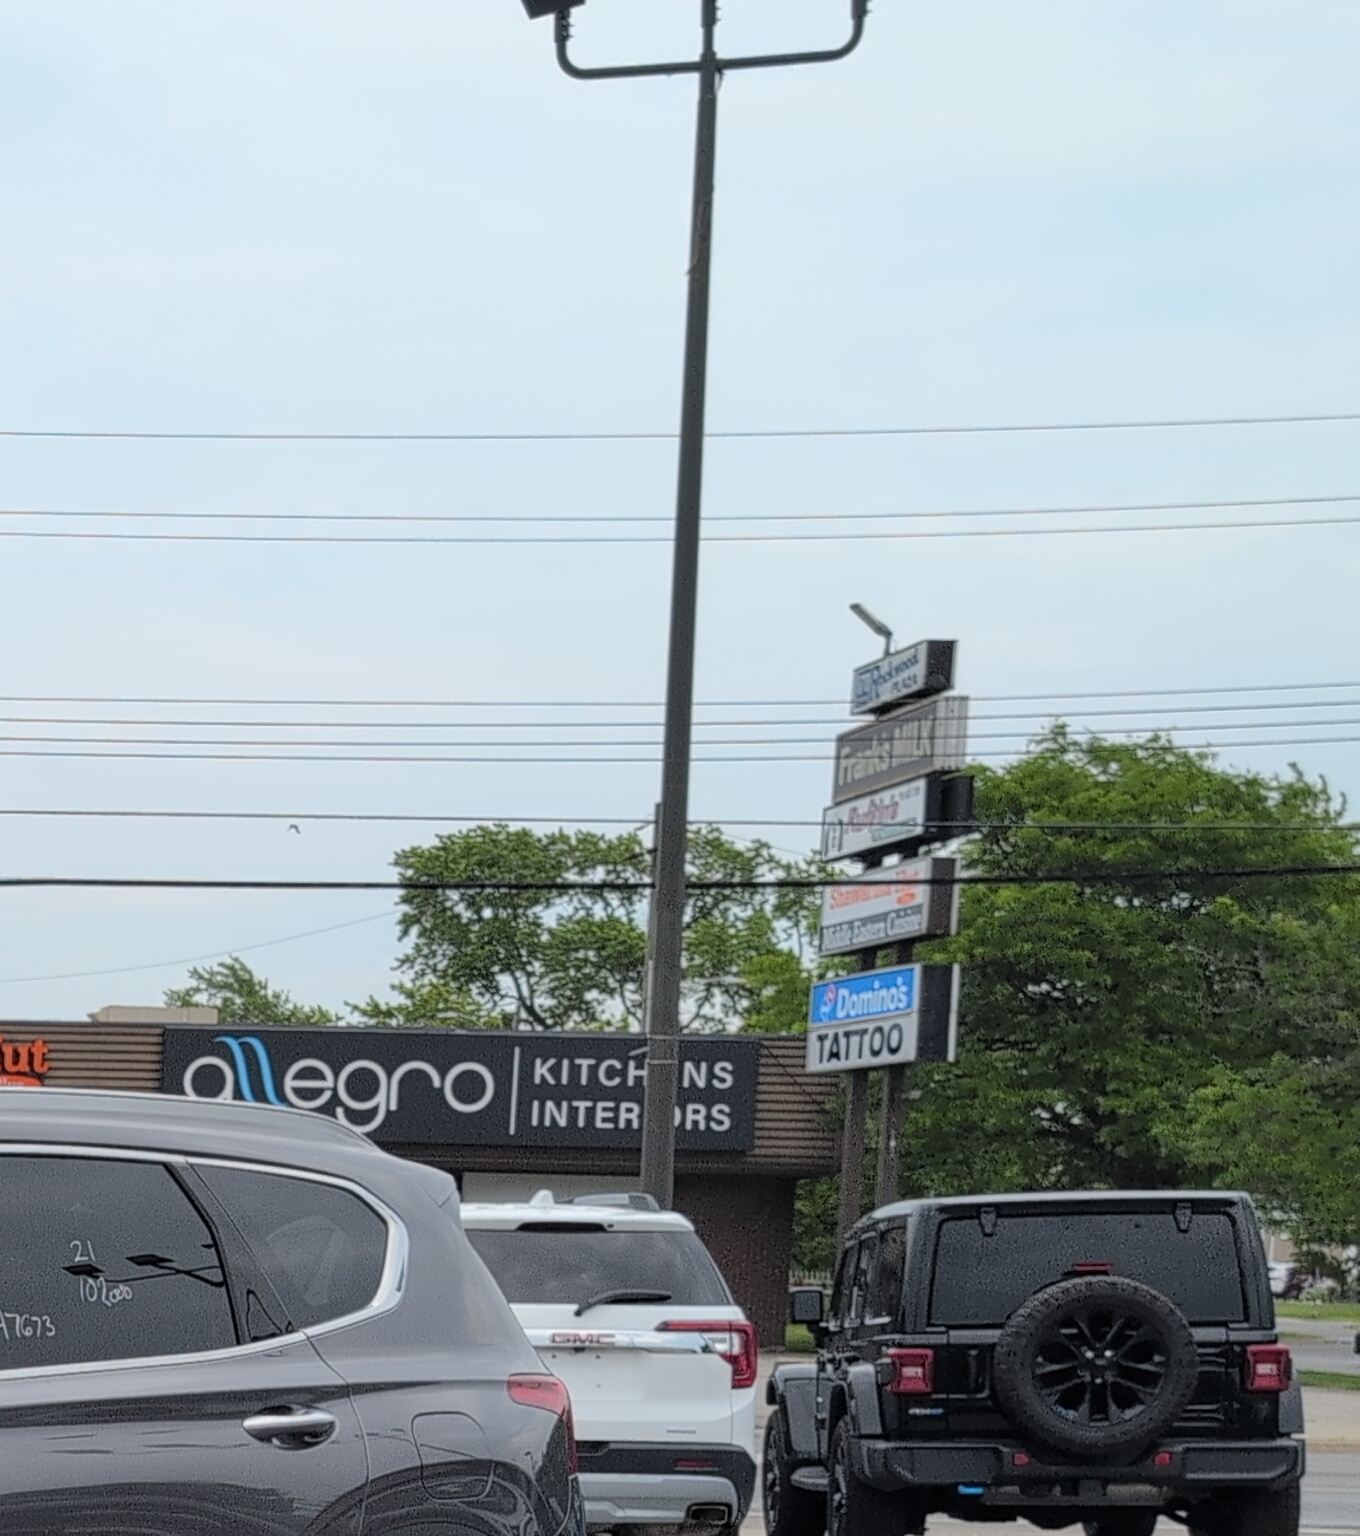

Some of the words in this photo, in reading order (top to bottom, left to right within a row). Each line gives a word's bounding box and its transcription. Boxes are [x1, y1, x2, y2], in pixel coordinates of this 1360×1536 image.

[836, 976, 908, 1019] Domino's
[817, 1023, 903, 1064] TATTOO
[183, 1036, 494, 1135] allegro
[533, 1057, 735, 1090] KITCHNS
[530, 1100, 732, 1132] INTERRS
[69, 1239, 96, 1262] 21
[551, 1333, 616, 1346] GMC
